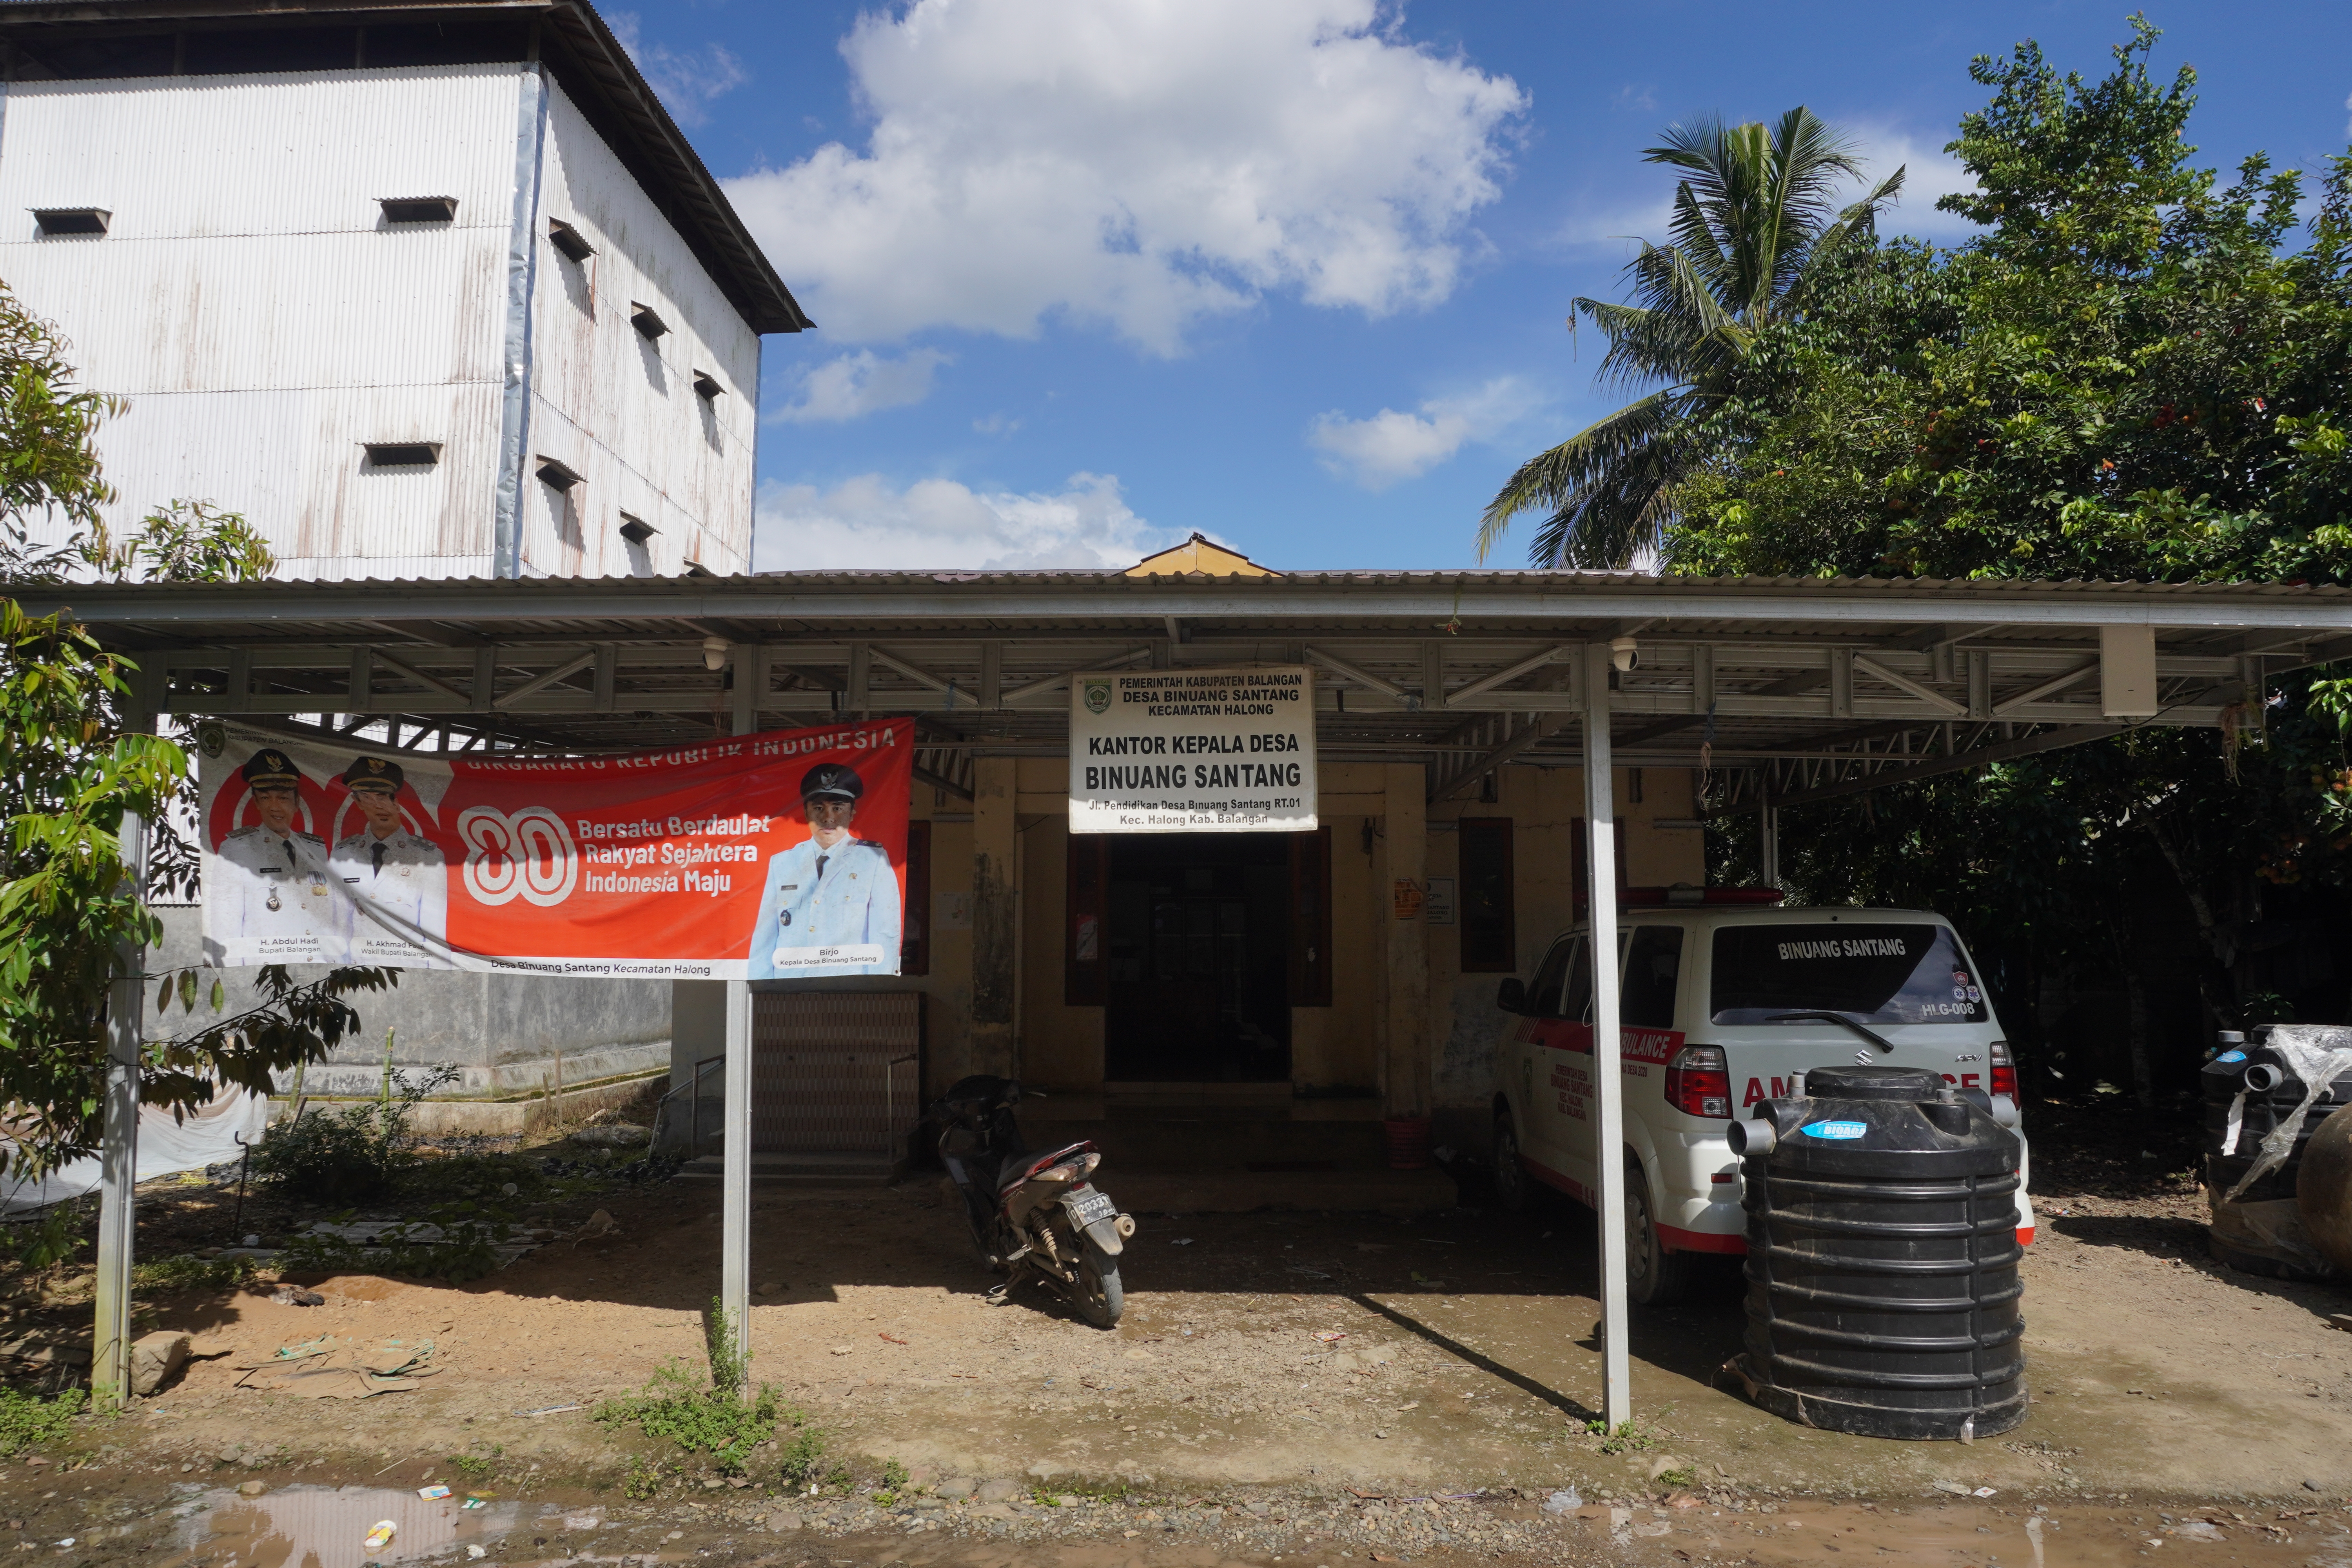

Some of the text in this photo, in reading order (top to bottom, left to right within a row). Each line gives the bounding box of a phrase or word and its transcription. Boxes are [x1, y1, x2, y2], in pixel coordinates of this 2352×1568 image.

[1120, 674, 1302, 689] PEMERINTAH KABUPATEN BALANGAN
[1123, 689, 1299, 703] DESA BINUANG SANTANG
[1148, 704, 1274, 716] KECAMATAN HALONG
[227, 735, 267, 743] KABUPATEN
[754, 728, 895, 755] INDONESIA
[1089, 734, 1299, 755] KANTOR KEPALA DESA
[1086, 763, 1301, 790] BINUANG SANTANG
[1089, 798, 1300, 811] Jl. Pendidikan Desa Binuang Santang RT.01
[577, 813, 769, 839] Bersatu Berdaulat
[1120, 813, 1268, 826] Kec. Halong Kab. Balangan
[584, 841, 757, 869] Rakyat Sejahtera
[585, 869, 730, 897] Indonesia Maju
[820, 948, 839, 956] Birjo
[1778, 938, 1906, 960] BINUANG SANTANG
[491, 959, 710, 976] Desa Binuang Santang Kecamatan Halong
[1922, 1002, 1975, 1016] HLG-008
[1555, 1063, 1588, 1082] PEMERINTAH DESA
[1628, 1064, 1637, 1076] DESA
[1638, 1066, 1648, 1077] 2020
[1551, 1073, 1593, 1099] BINUANG SANTANG
